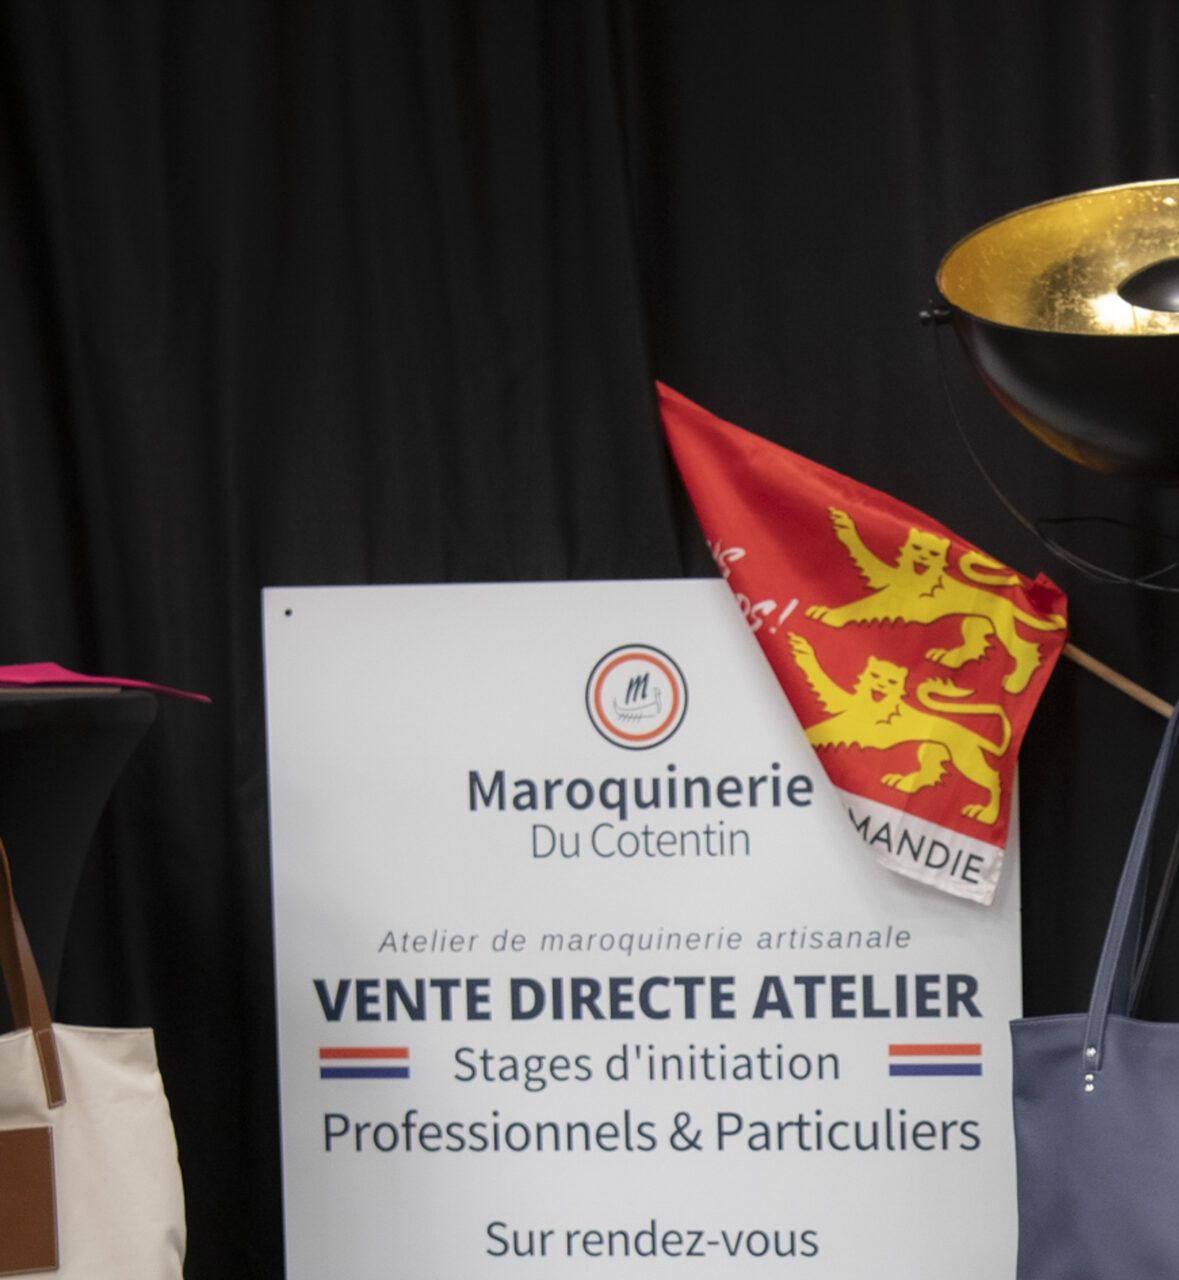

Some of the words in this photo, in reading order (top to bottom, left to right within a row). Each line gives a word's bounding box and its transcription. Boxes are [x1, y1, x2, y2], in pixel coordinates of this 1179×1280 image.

[467, 762, 815, 821] Maroquinerie
[531, 823, 580, 859] Du
[590, 821, 751, 859] Cotentin
[377, 929, 476, 953] Atelier
[491, 929, 526, 953] de
[540, 928, 743, 957] maroquinerie
[756, 925, 911, 950] artisanale
[313, 978, 491, 1022] VENTE
[509, 976, 736, 1021] DIRECTE
[752, 973, 983, 1019] ATELIER
[453, 1046, 593, 1093] Stages
[605, 1043, 840, 1082] d'initiation
[322, 1108, 657, 1153] Professionnels
[669, 1110, 703, 1152] &
[716, 1107, 982, 1152] Particuliers
[486, 1220, 555, 1258] Sur
[565, 1219, 820, 1258] rendez-vous
